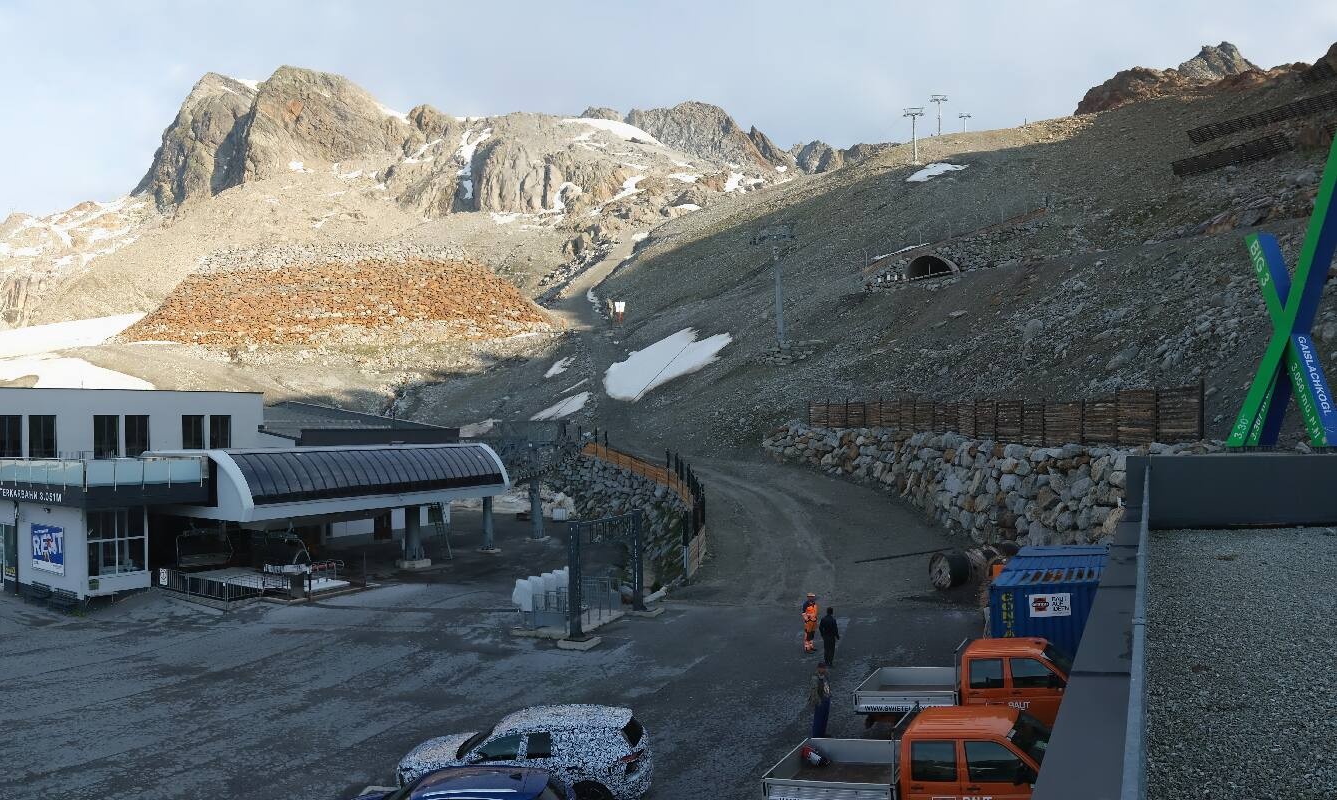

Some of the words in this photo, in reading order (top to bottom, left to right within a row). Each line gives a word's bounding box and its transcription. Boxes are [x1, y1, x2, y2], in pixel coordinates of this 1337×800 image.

[1250, 239, 1265, 272] BIG
[1261, 272, 1270, 287] 3
[1298, 336, 1332, 416] GAISLACHKOGL
